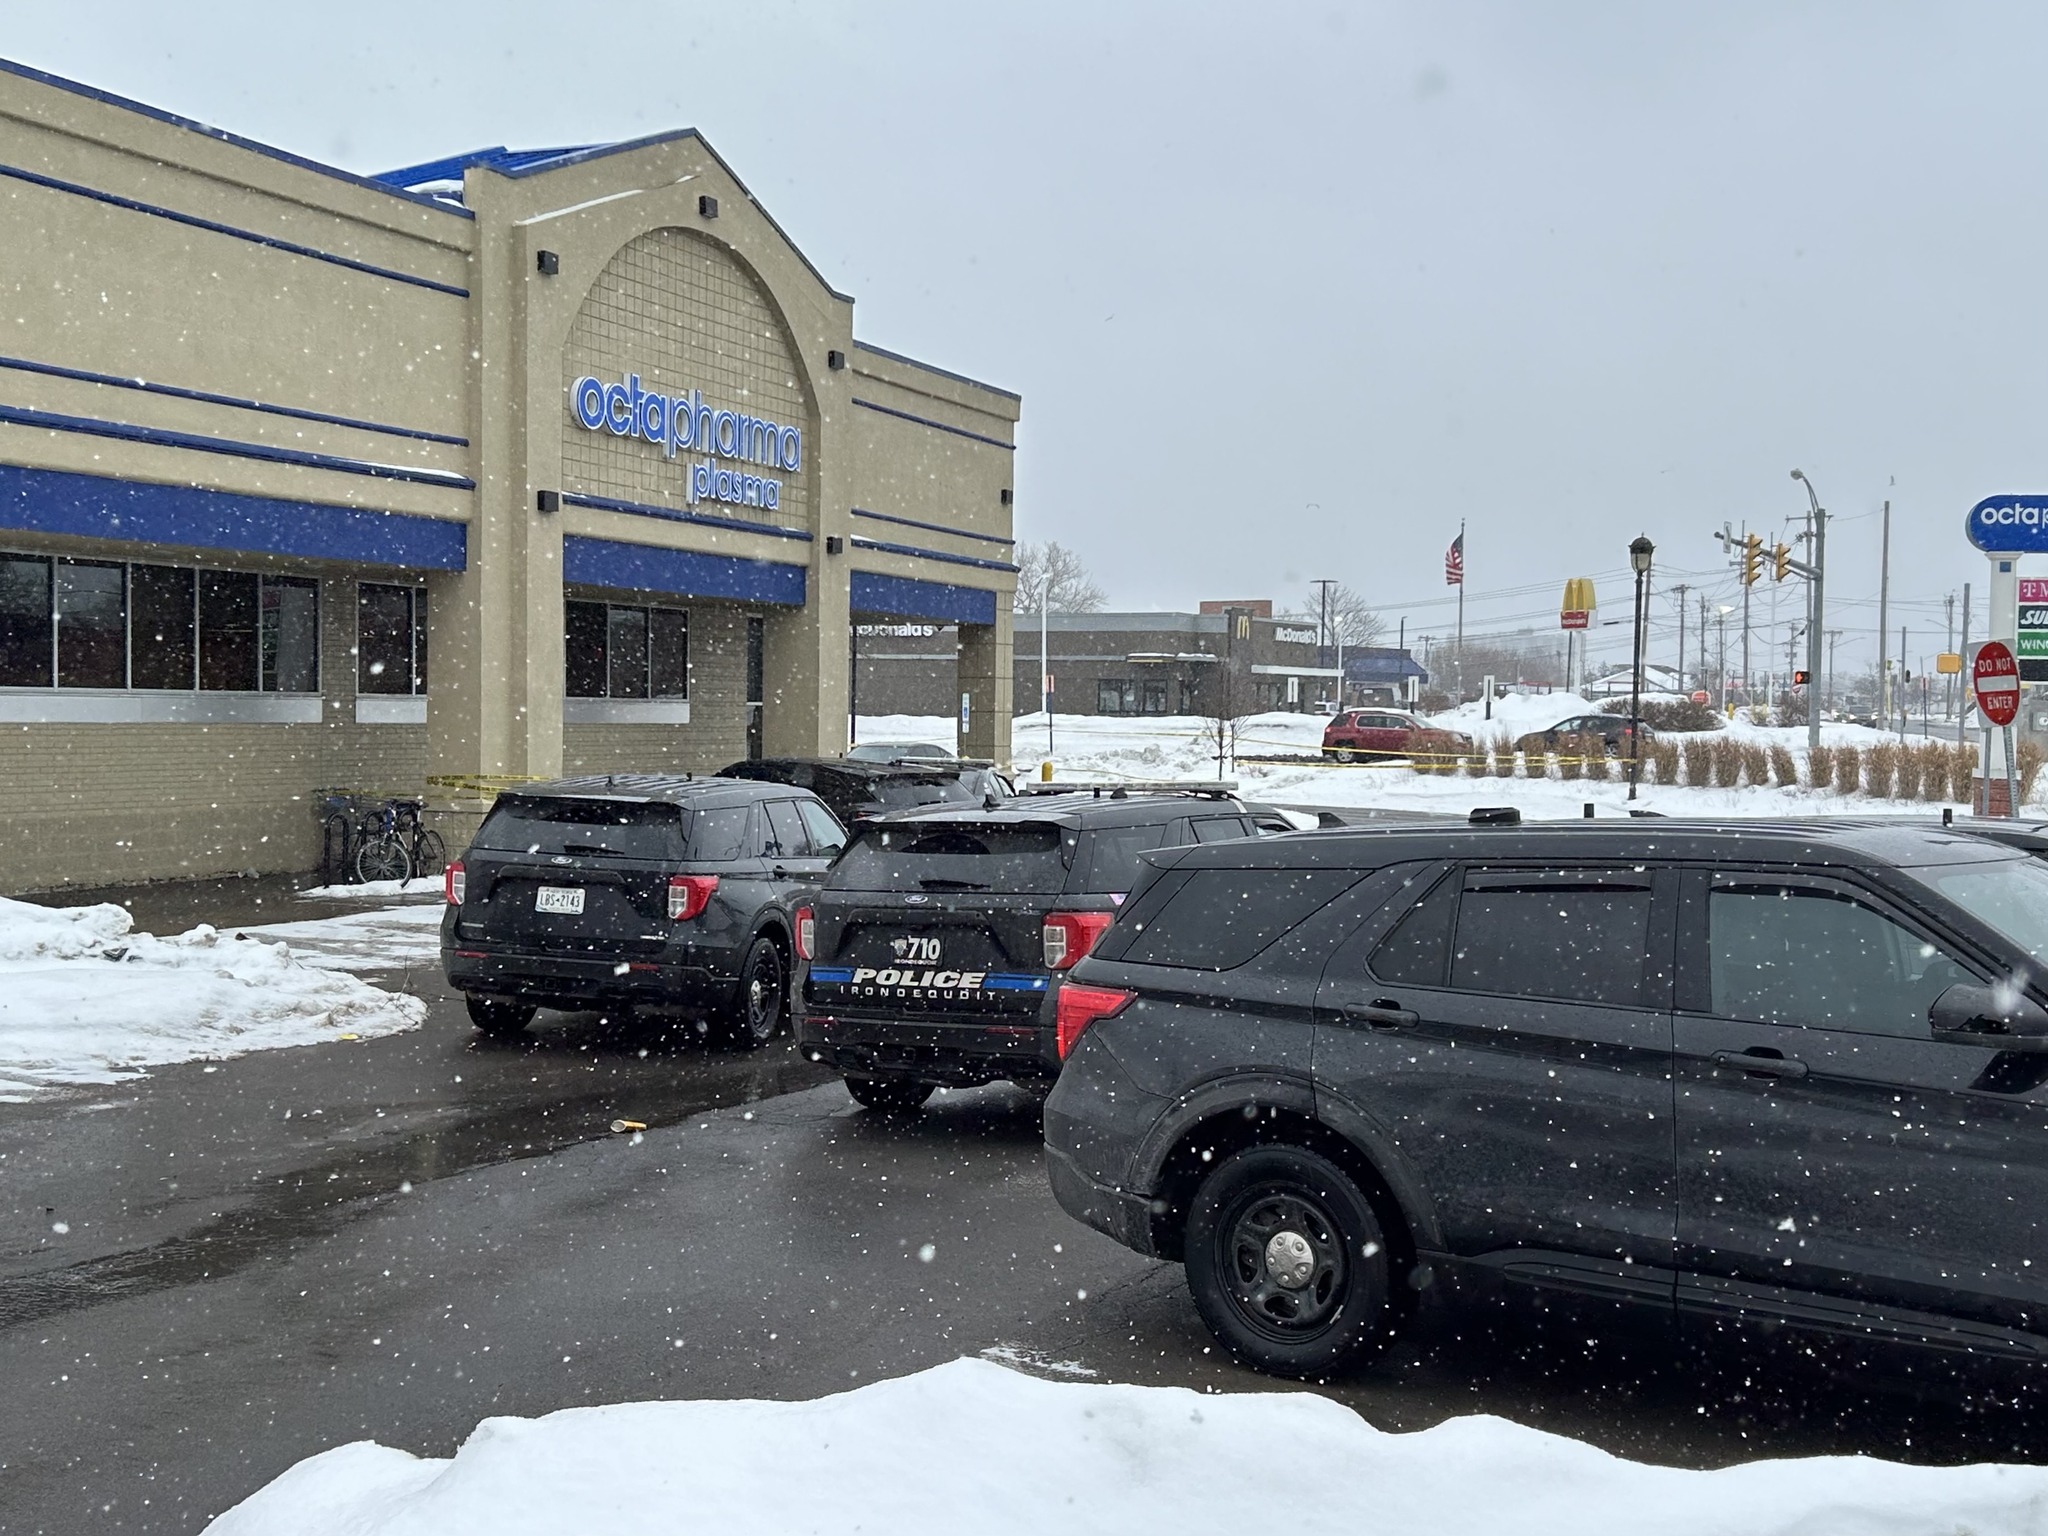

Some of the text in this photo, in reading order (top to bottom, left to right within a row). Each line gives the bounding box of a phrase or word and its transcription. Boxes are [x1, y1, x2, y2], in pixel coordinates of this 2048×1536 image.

[570, 373, 801, 472] octapharma
[686, 457, 781, 510] plasma
[1275, 626, 1317, 645] McDonald's
[1979, 657, 2012, 672] DO NOT
[1987, 696, 2013, 710] ENTER
[560, 894, 581, 908] 2143
[907, 937, 941, 960] 710
[852, 967, 986, 989] POLICE
[840, 985, 996, 1001] IRONDEQUOIT
